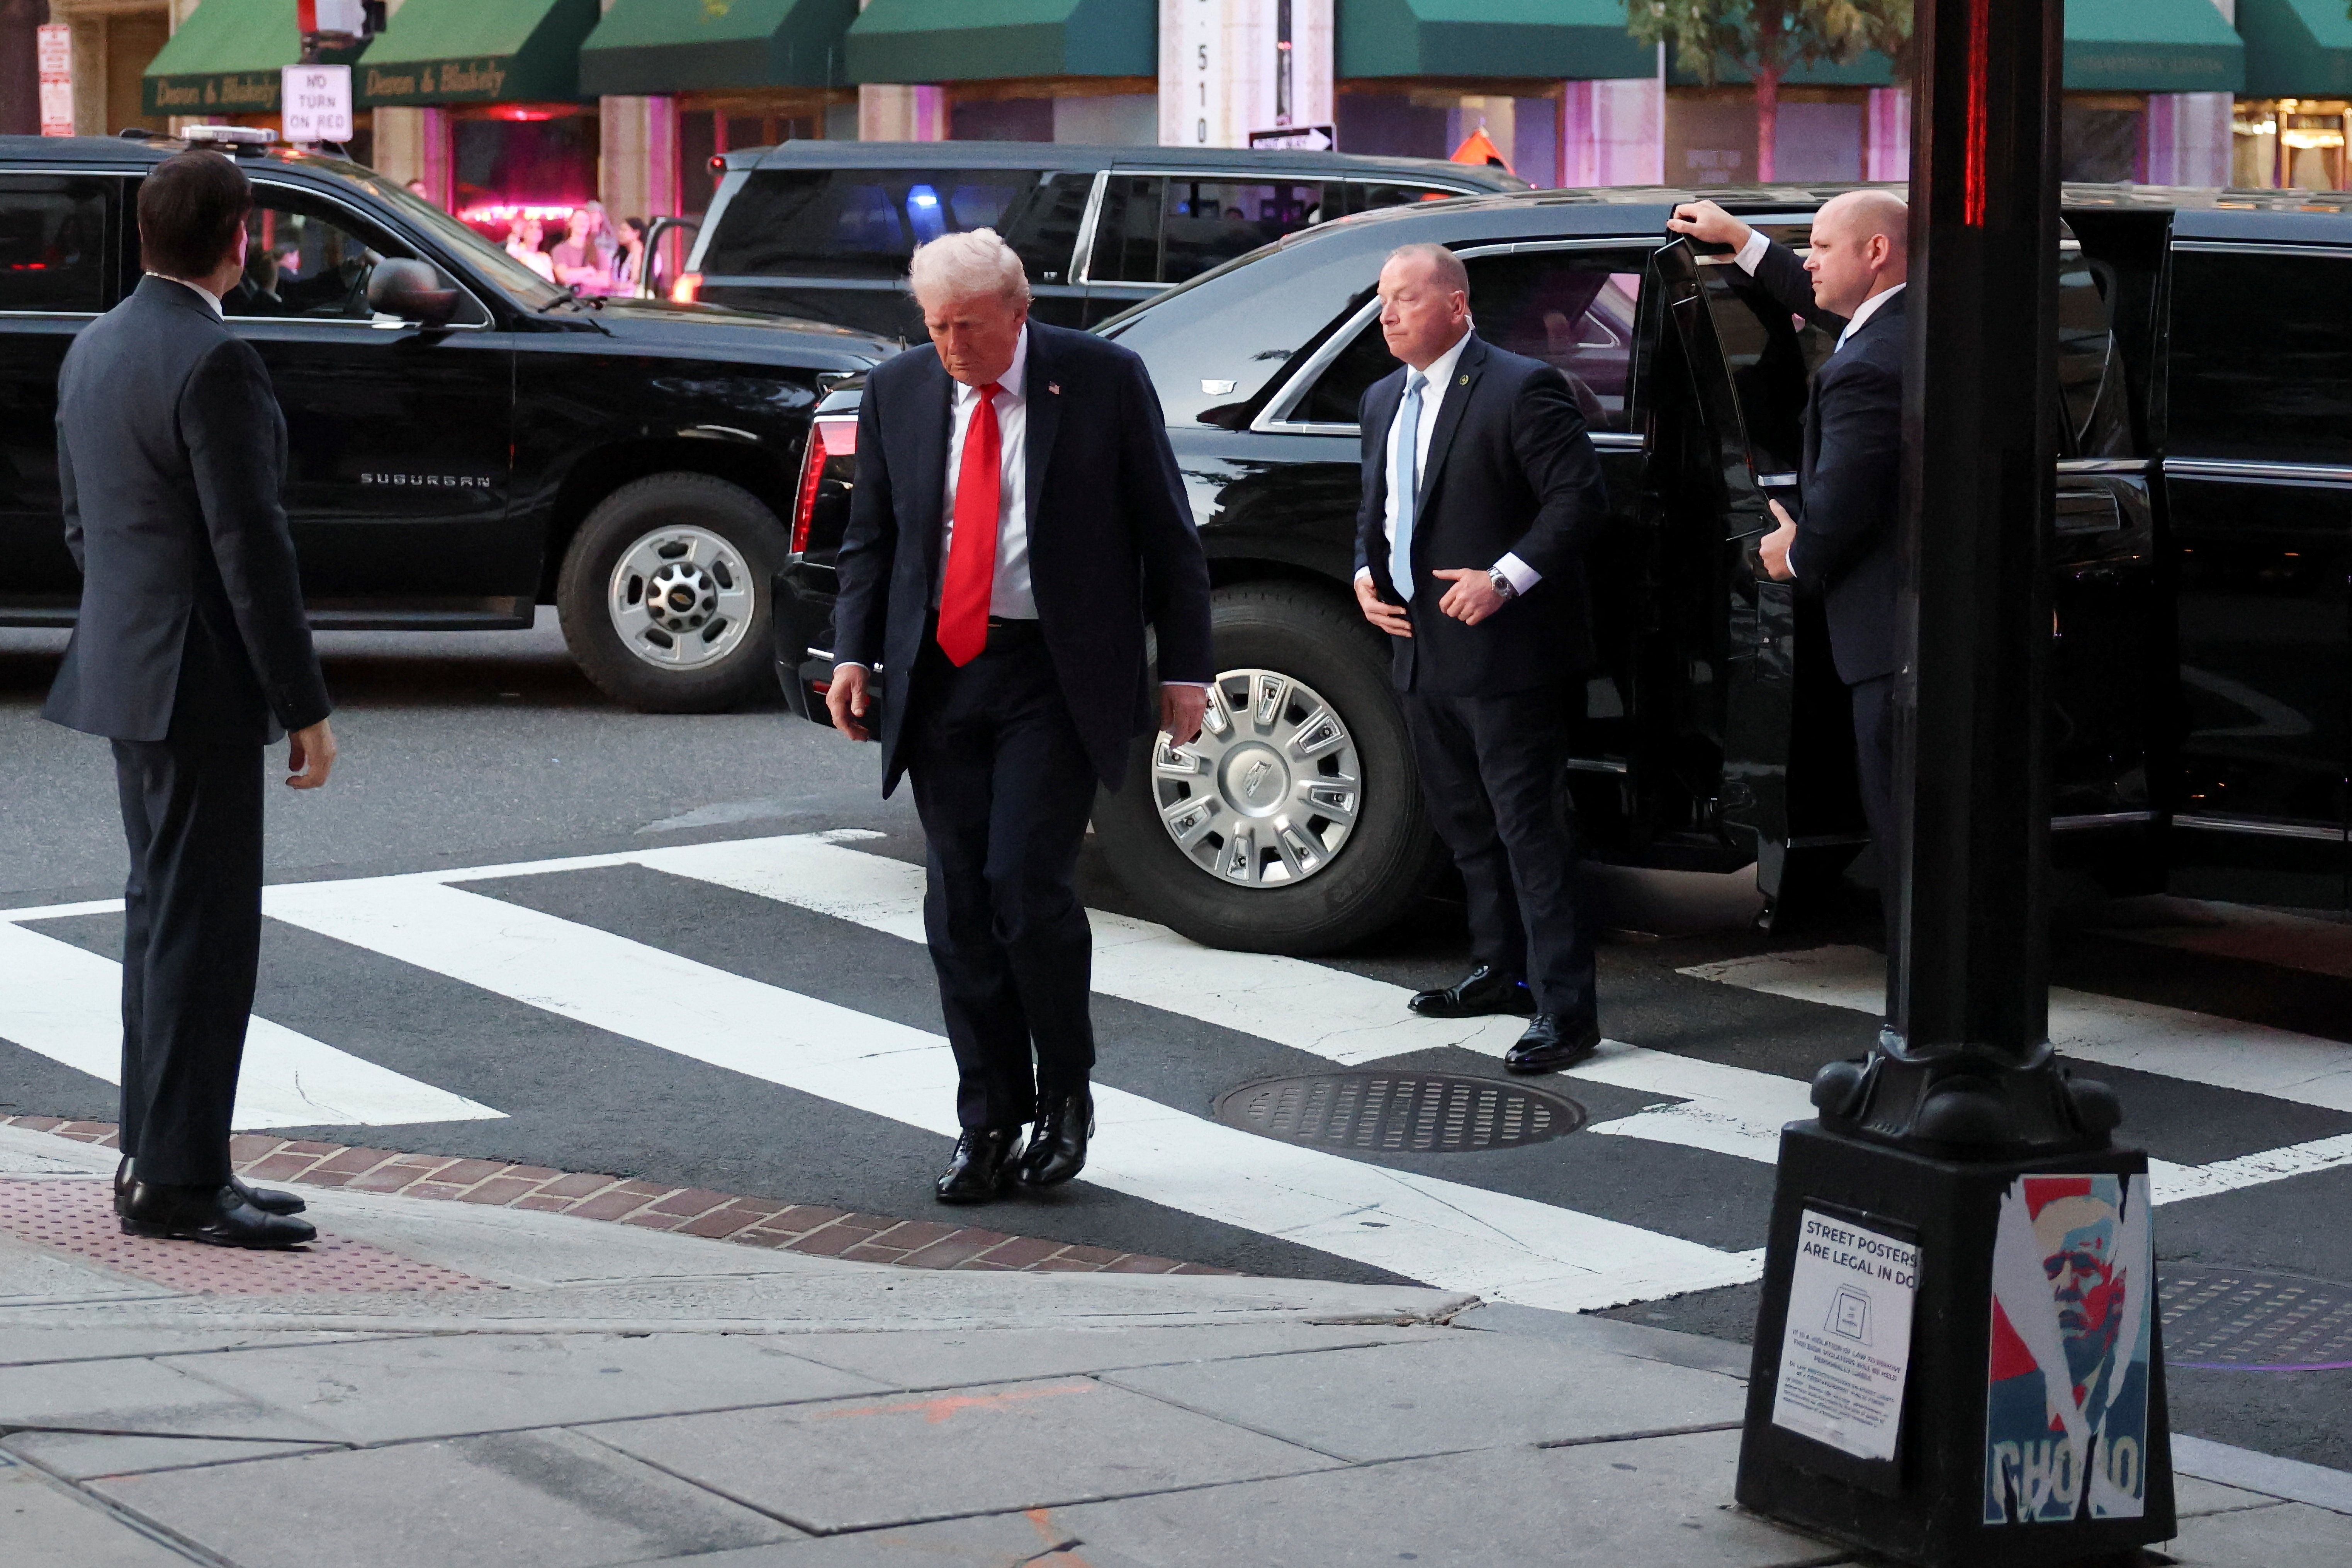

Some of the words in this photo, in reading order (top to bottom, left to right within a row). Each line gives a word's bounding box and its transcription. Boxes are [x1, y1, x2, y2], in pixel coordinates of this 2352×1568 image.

[307, 75, 326, 89] NO
[299, 94, 336, 109] TURN
[290, 114, 309, 129] ON
[318, 114, 345, 129] RED
[361, 473, 490, 487] SUBURBAN
[1807, 1220, 1855, 1246] STREET
[1858, 1237, 1917, 1268] POSTERS
[1803, 1241, 1830, 1260] ARE
[1832, 1250, 1874, 1274] LEGAL
[1878, 1265, 1892, 1281] IN
